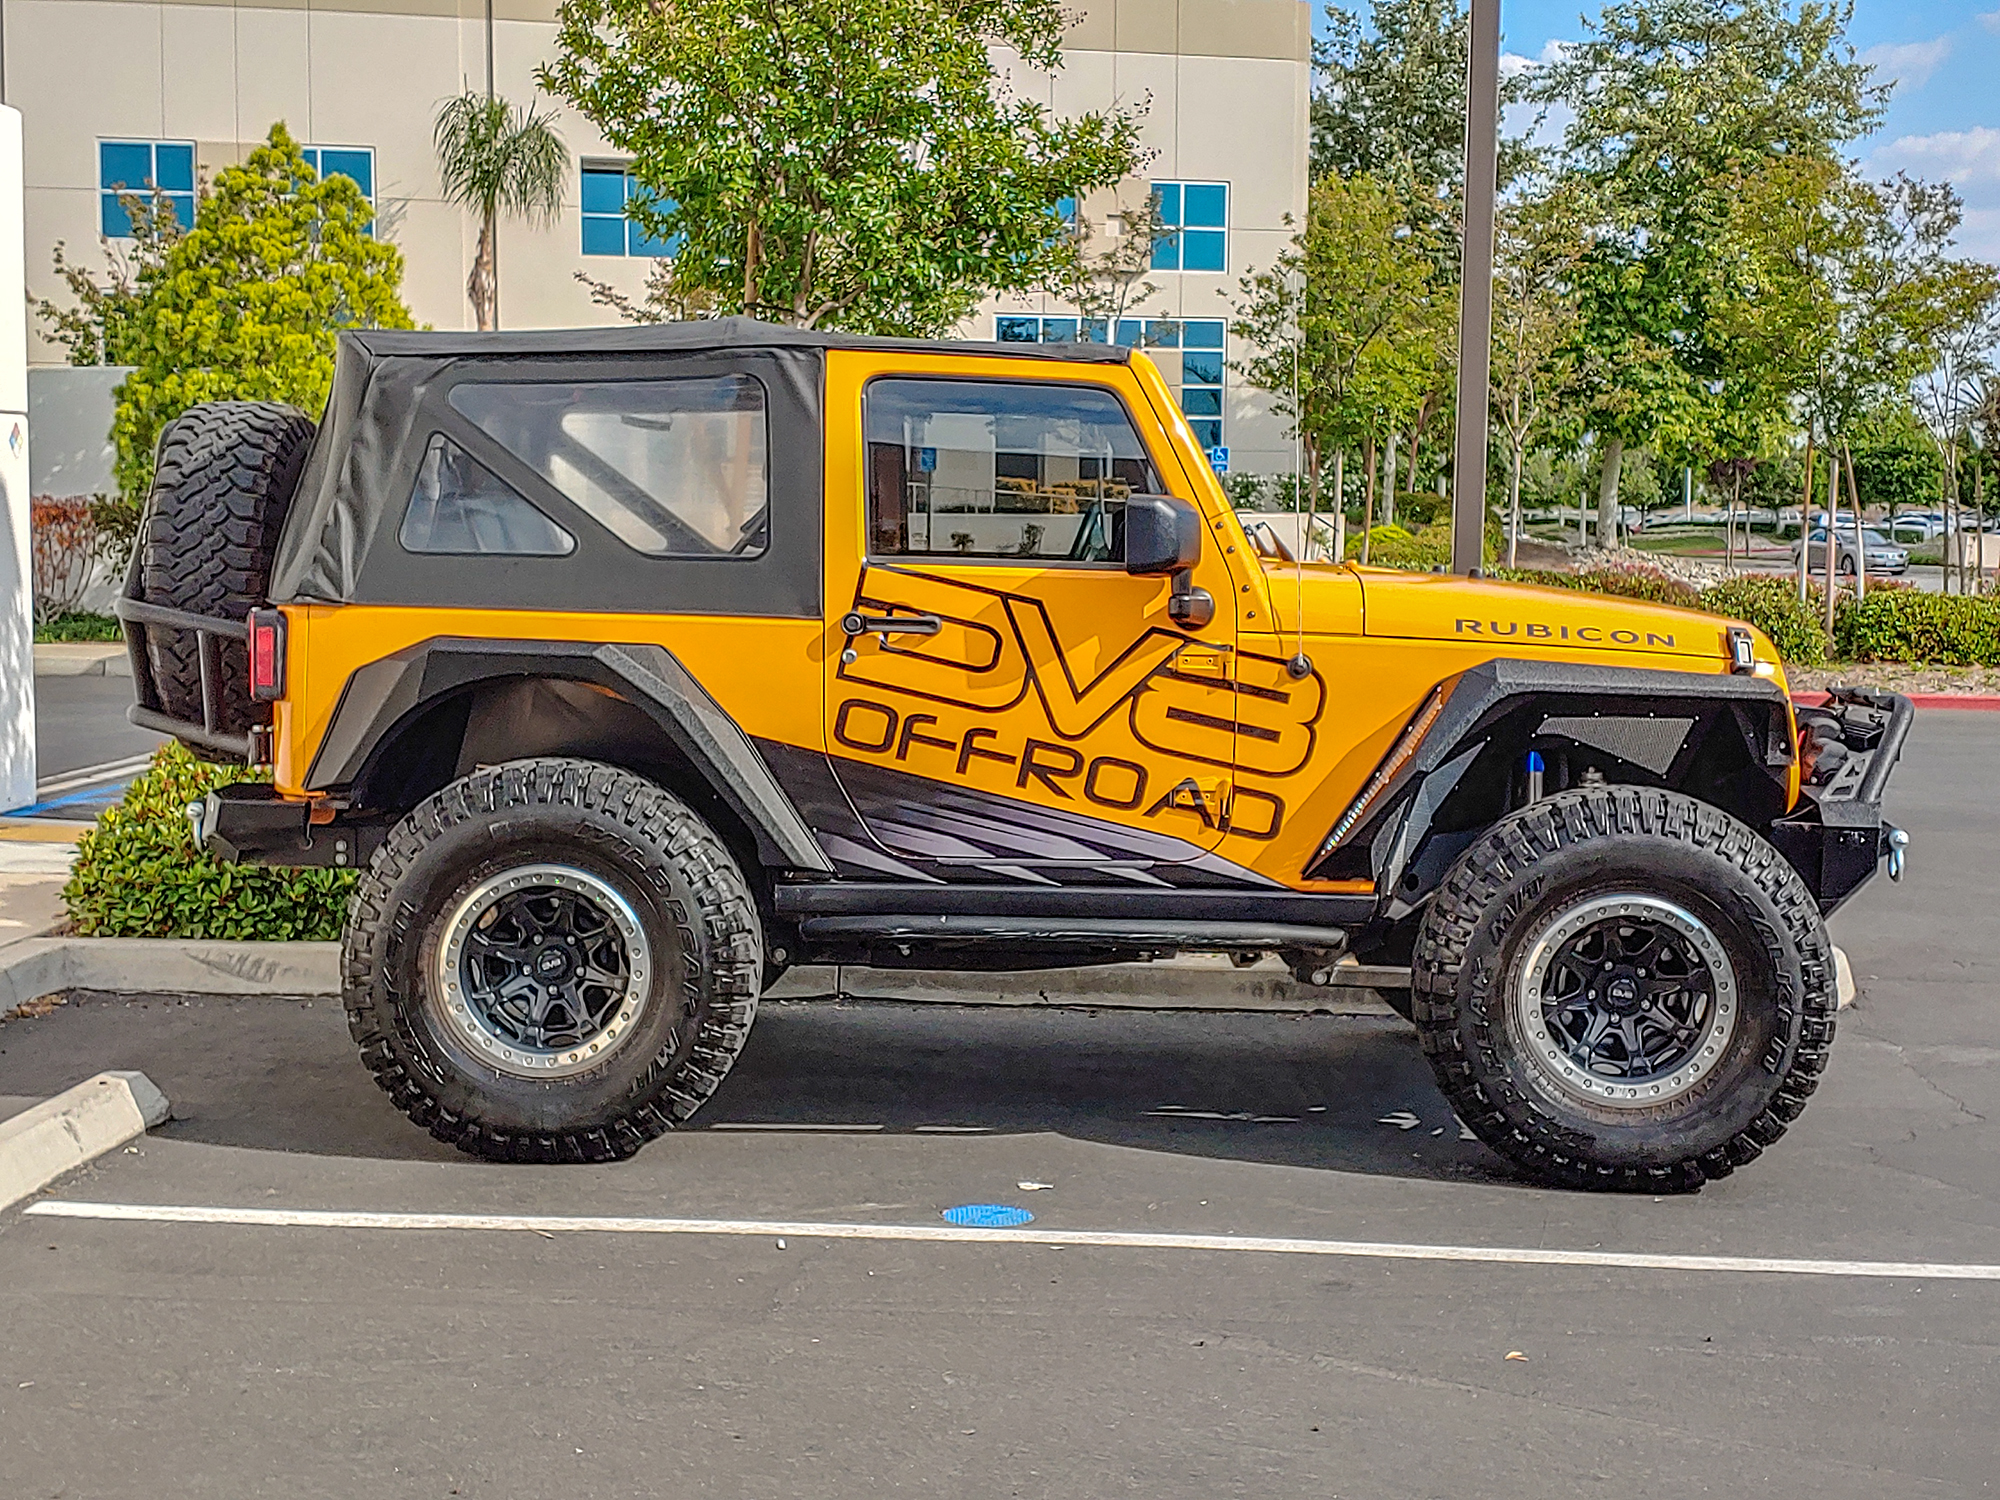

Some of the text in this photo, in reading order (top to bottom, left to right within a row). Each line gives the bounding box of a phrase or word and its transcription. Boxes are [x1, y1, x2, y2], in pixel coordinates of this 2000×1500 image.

[836, 562, 1328, 778] DV8
[1455, 618, 1676, 648] RUBICON
[833, 697, 1286, 840] OFFROAD
